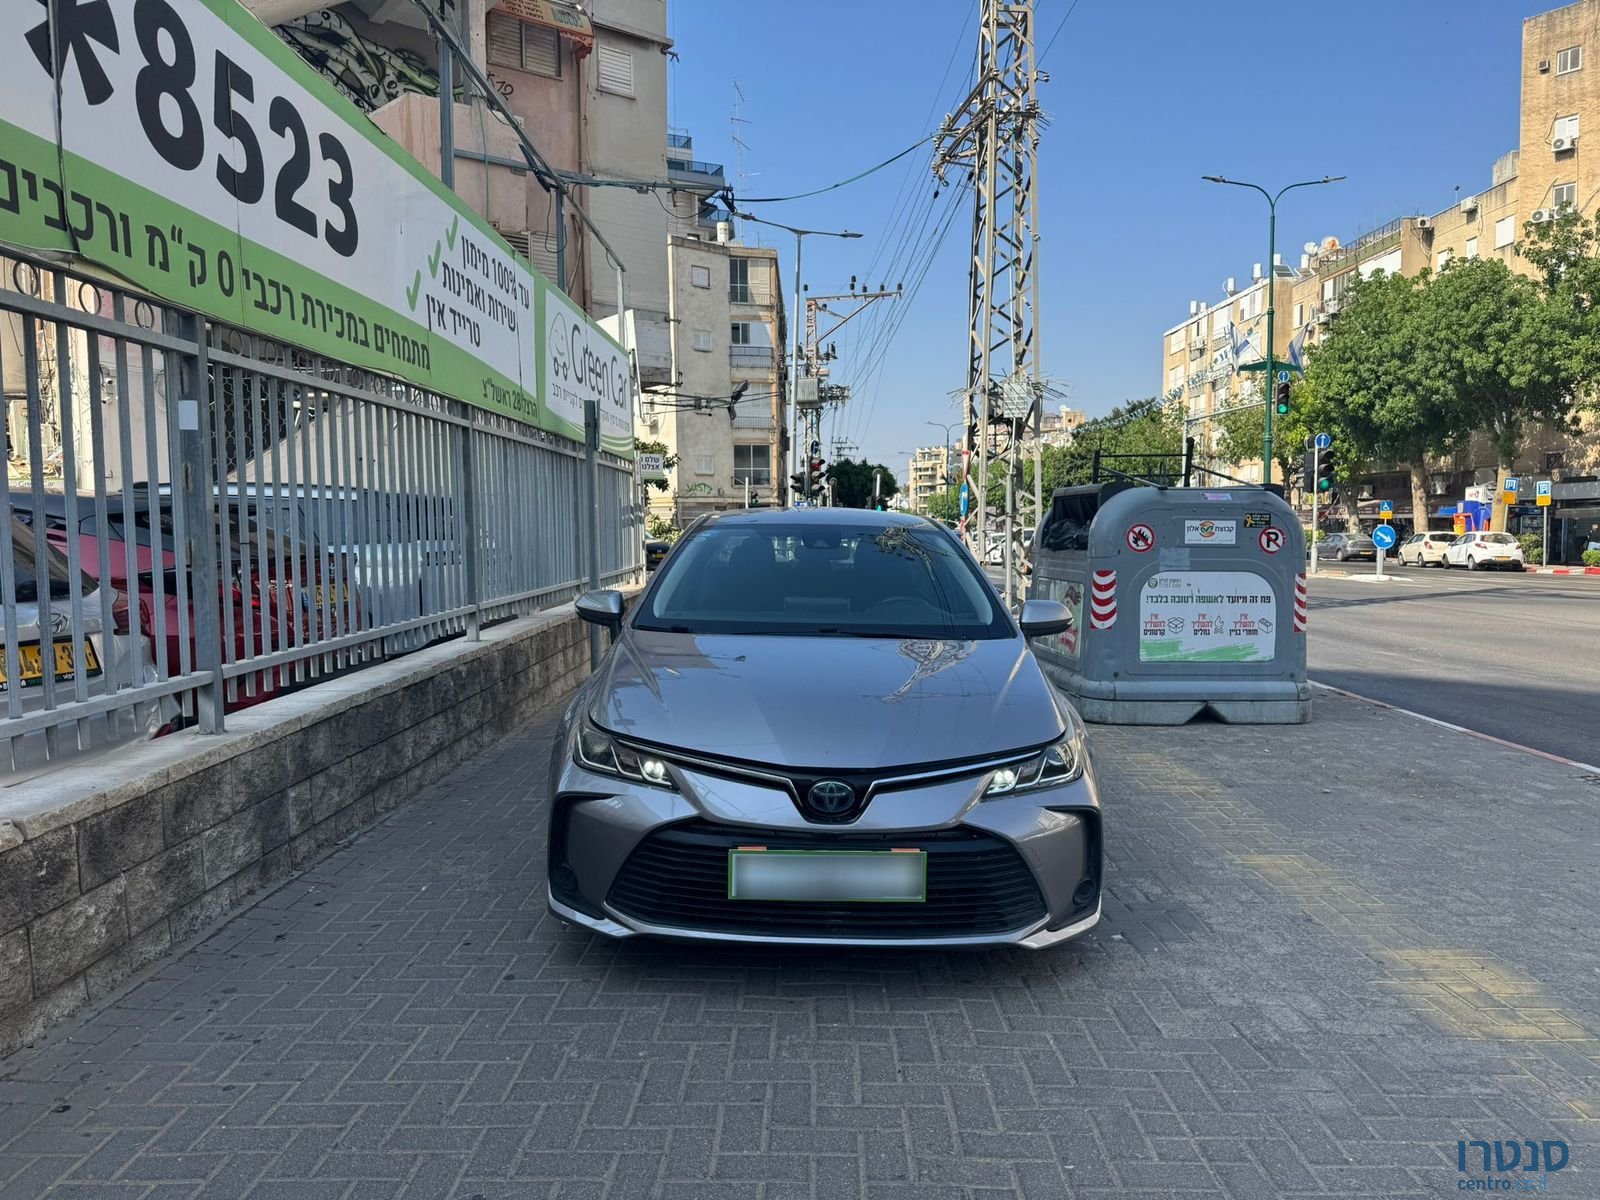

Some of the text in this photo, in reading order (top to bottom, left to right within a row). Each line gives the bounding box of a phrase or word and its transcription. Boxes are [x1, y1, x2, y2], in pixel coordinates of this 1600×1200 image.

[217, 250, 234, 298] 0
[242, 267, 296, 321] רכבי
[442, 261, 516, 332] שירות ואמינות
[461, 235, 530, 310] עד 100% מימון
[301, 292, 370, 348] במכירת
[426, 293, 480, 347] טרייד אין
[374, 322, 431, 371] מתמחים
[571, 323, 627, 410] Green Car
[512, 390, 521, 412] 28
[1215, 526, 1235, 534] קבוצת
[1146, 593, 1271, 604] פח זה מיועד לאשפה רטובה בלבד!
[1143, 628, 1165, 637] קרטונים
